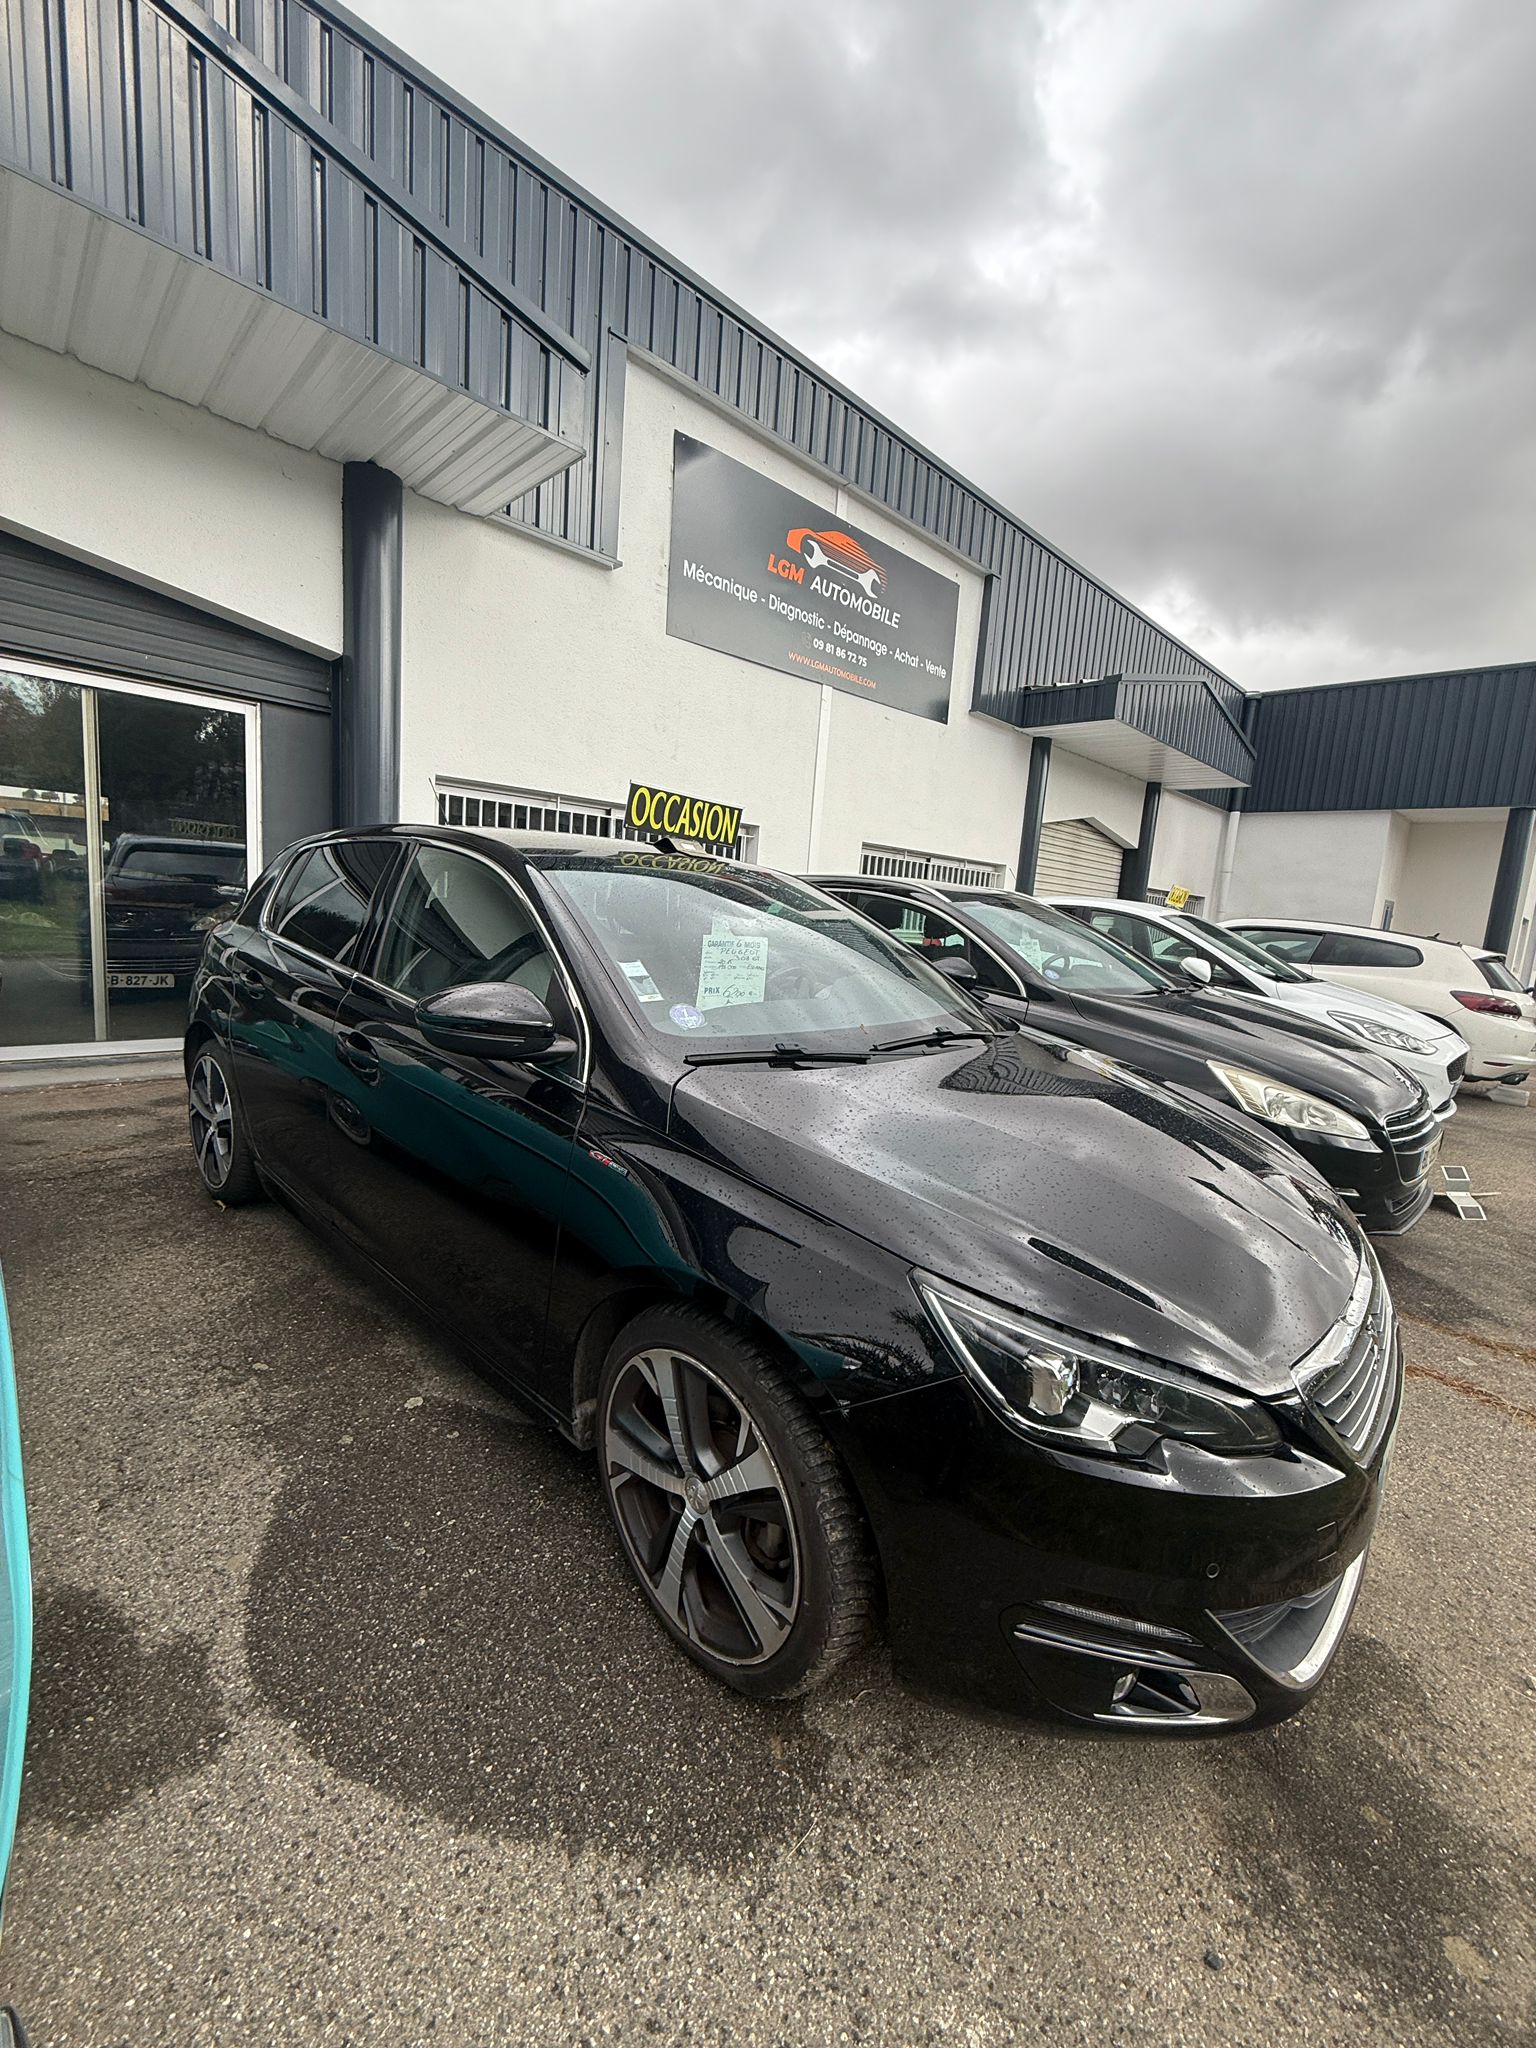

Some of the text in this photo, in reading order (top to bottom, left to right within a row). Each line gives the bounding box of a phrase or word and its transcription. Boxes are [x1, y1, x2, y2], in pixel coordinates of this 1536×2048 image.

[768, 553, 901, 629] LGM AUTOMOBILE
[683, 559, 758, 603] Mécanique
[769, 593, 825, 630] Diagnostic
[833, 621, 888, 657] Dépannage
[894, 648, 919, 669] Achat
[925, 659, 947, 679] Vente
[813, 637, 868, 667] 09 81 86 72 75
[788, 651, 877, 689] WWW.LGMAUTOMOBILE.COM
[631, 787, 739, 845] OCCASION
[720, 948, 760, 956] PEUGEOT
[107, 975, 169, 986] B-827-JK
[704, 986, 720, 994] PRIX
